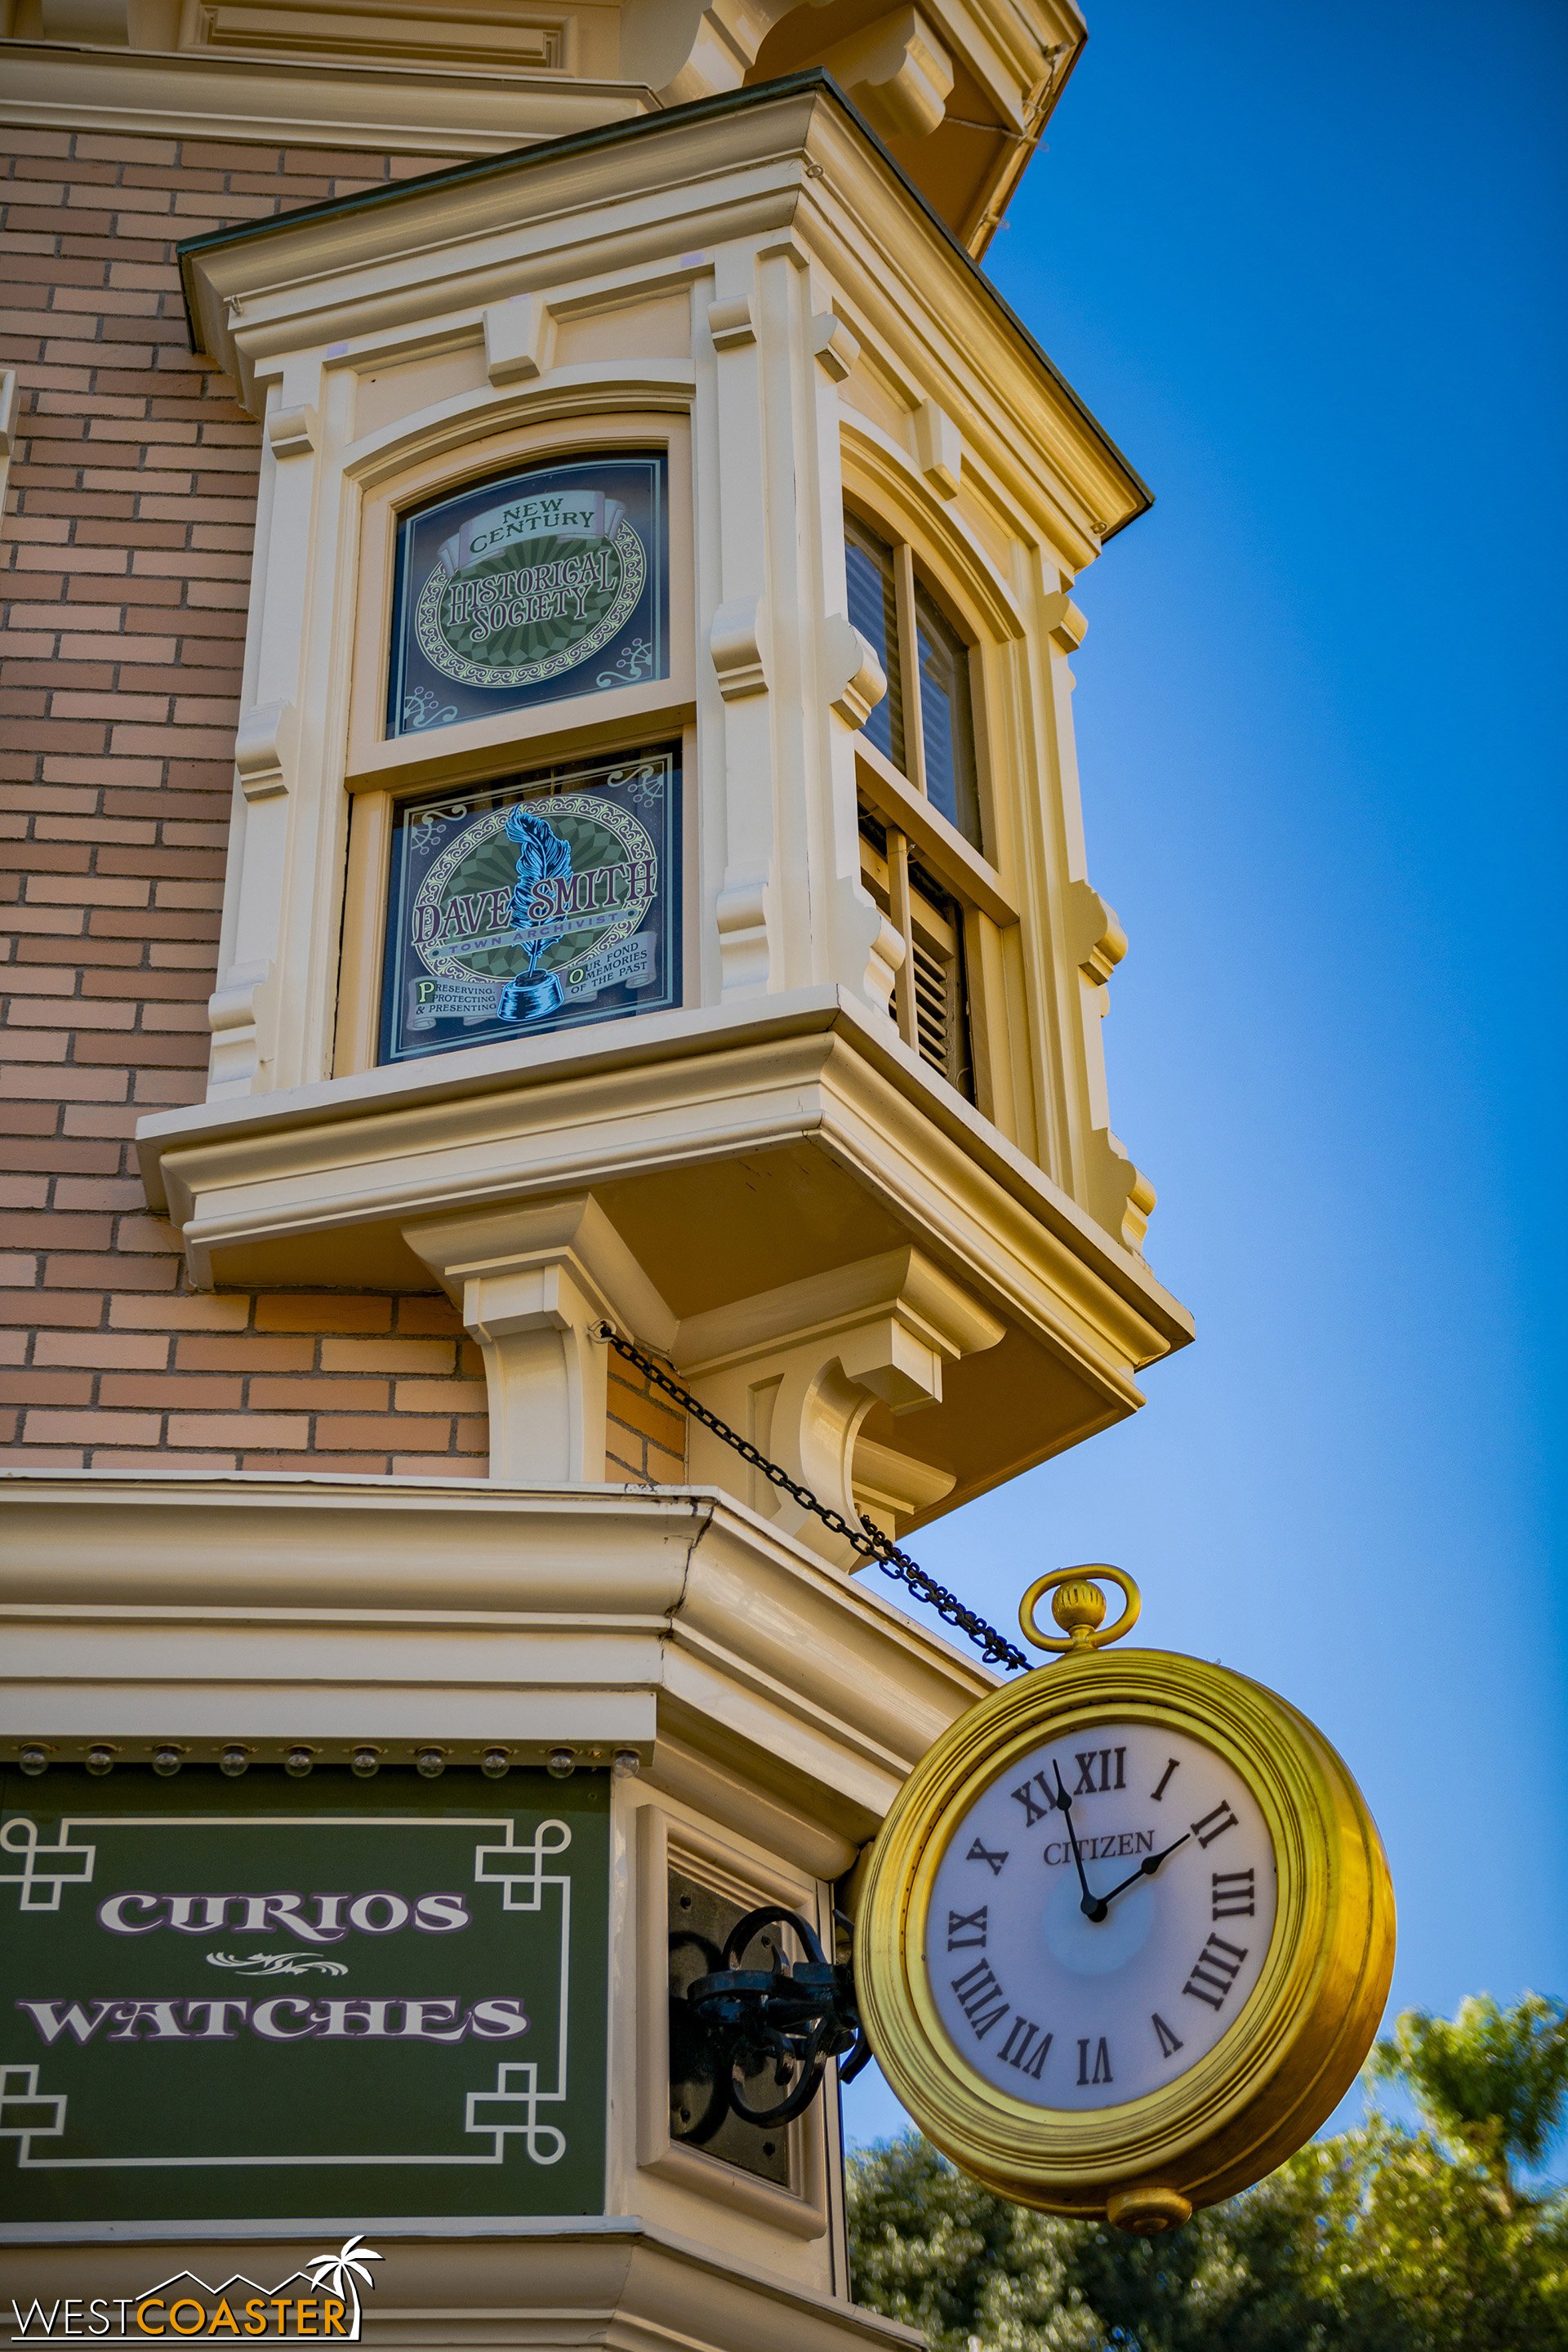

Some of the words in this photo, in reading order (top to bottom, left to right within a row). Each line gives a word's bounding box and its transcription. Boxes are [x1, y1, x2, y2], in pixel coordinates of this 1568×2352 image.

[469, 511, 595, 555] CENTURY
[502, 497, 564, 524] NEW
[449, 550, 617, 627] HISTORICAL
[470, 584, 592, 642] SOCIETY
[412, 887, 512, 945] DAVE
[528, 858, 657, 921] SMITH
[449, 936, 503, 953] TOWN
[512, 912, 619, 942] ARCHIVIST
[568, 959, 601, 985] OUR
[606, 942, 639, 963] FOND
[570, 983, 587, 995] OF
[591, 972, 614, 987] THE
[619, 960, 648, 978] PAST
[585, 950, 648, 980] MEMORIES
[416, 1005, 425, 1015] &
[429, 1003, 497, 1013] PRESENTING
[434, 993, 497, 1004] PROTECTING
[1073, 1747, 1127, 1796] XII
[1010, 1770, 1058, 1829] XI
[1043, 1829, 1156, 1865] CITIZEN
[1190, 1799, 1240, 1850] II
[965, 1837, 1009, 1876] X
[97, 1891, 471, 1943] CURIOS
[1212, 1868, 1255, 1922] III
[947, 1904, 988, 1953] IX
[16, 1995, 531, 2045] WATCHES
[951, 1958, 1011, 2041] VIII
[996, 2015, 1054, 2081] VII
[1076, 2036, 1114, 2086] VI
